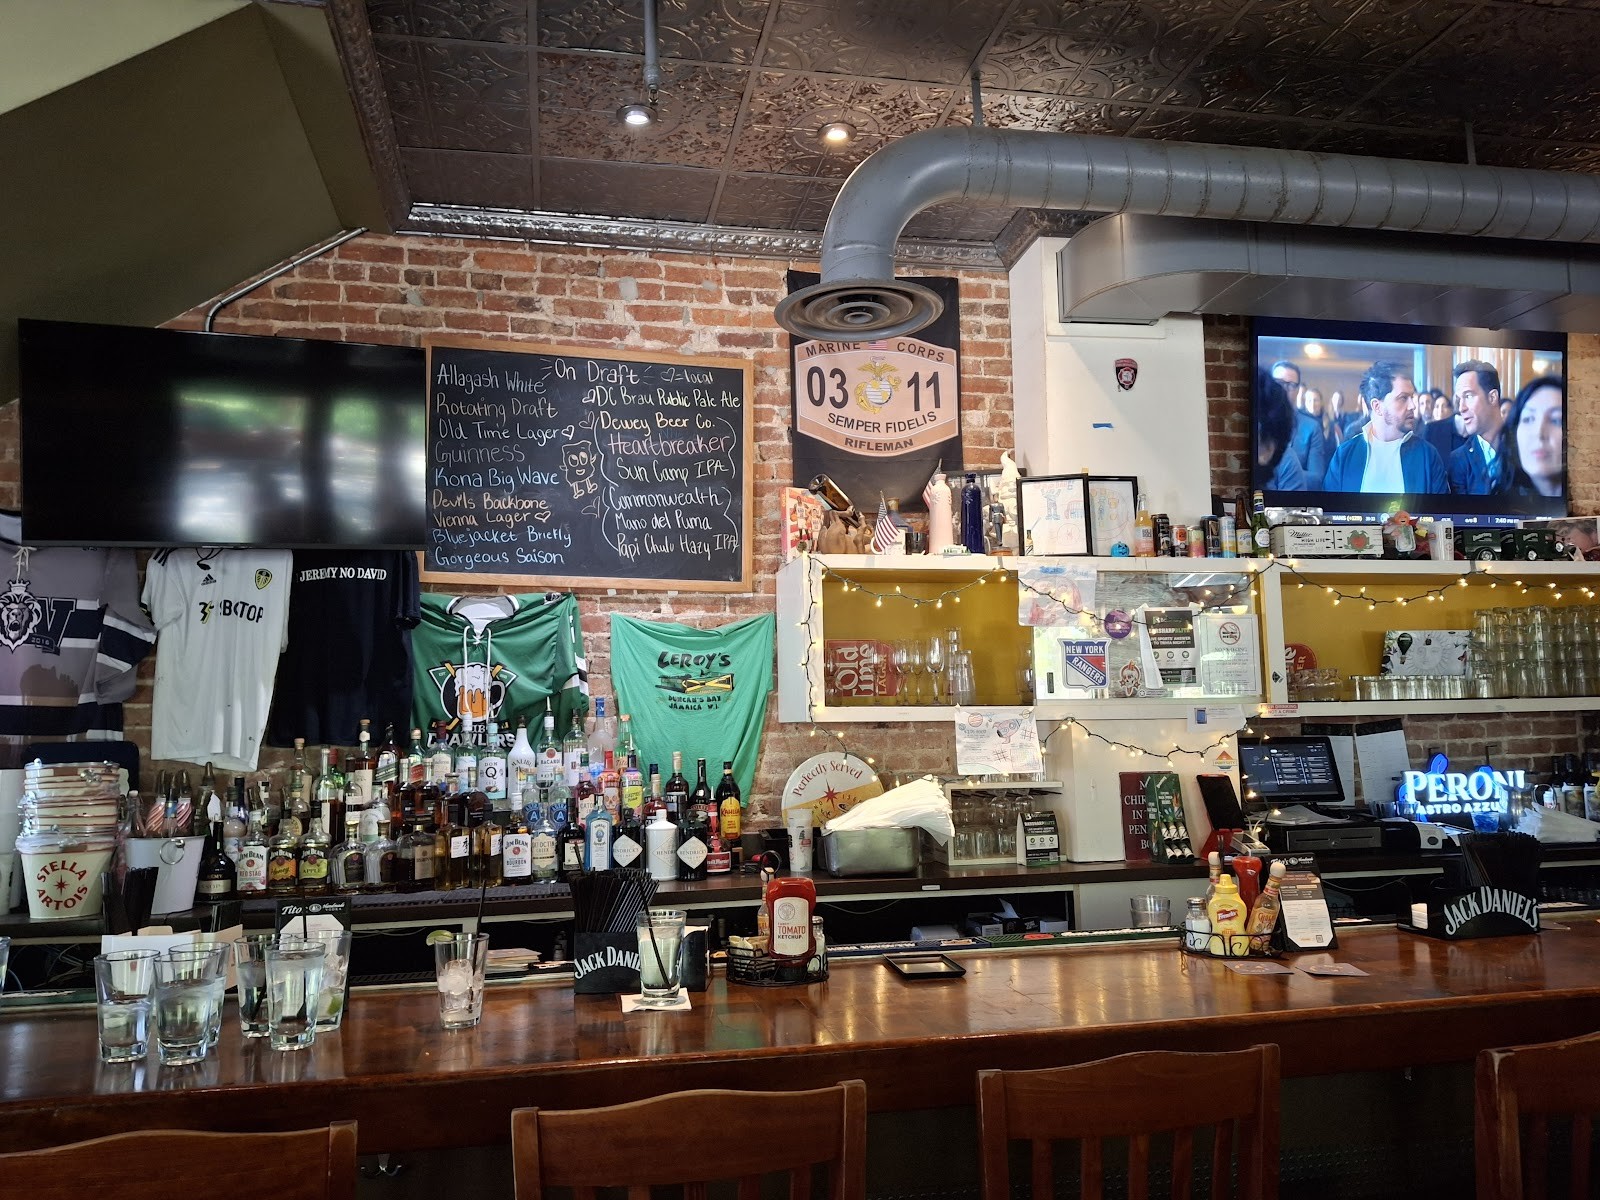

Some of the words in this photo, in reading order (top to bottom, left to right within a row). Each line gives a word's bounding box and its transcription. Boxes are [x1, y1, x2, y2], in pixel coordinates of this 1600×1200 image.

[805, 341, 861, 358] MARINE
[896, 342, 945, 362] CORPS
[437, 363, 499, 395] Allagash
[505, 370, 547, 394] White
[555, 358, 576, 380] On
[587, 360, 640, 385] Draft
[595, 385, 617, 407] DC
[620, 385, 655, 405] Brau
[657, 387, 691, 407] Public
[693, 388, 717, 407] Pale
[720, 390, 741, 408] Ale
[806, 365, 849, 410] 03
[907, 371, 941, 412] 11
[436, 392, 506, 427] Rotating
[511, 396, 558, 419] Draft
[439, 418, 468, 440] Old
[472, 421, 511, 440] Time
[516, 422, 560, 447] Lager
[599, 410, 651, 437] Dewey
[655, 411, 690, 429] Beer
[695, 413, 715, 429] Co.
[827, 412, 881, 434] SEMPER
[885, 411, 937, 434] FIDELIS
[435, 440, 525, 468] Guinness
[607, 431, 731, 457] Heartbreaker
[844, 437, 914, 452] RIFLEMAN
[435, 466, 483, 487] Kona
[487, 468, 515, 494] Big
[516, 464, 560, 485] Wave
[616, 456, 650, 483] Sun
[653, 459, 689, 487] Camp
[693, 458, 729, 479] IPA
[483, 491, 549, 510] Backbone
[609, 486, 724, 511] Commonwealth
[433, 512, 479, 528] Vienna
[486, 511, 531, 529] Lager
[614, 512, 647, 531] Mano
[651, 511, 672, 530] del
[675, 508, 713, 531] Puma
[432, 527, 518, 548] Bluejacket
[617, 532, 641, 562] Papi
[644, 533, 675, 554] Chulo
[679, 533, 711, 561] Hazy
[712, 533, 737, 551] IPA
[435, 546, 509, 570] Gorgeous
[516, 547, 565, 564] Saison
[300, 567, 339, 582] JEREMY
[339, 567, 355, 579] NO
[356, 567, 387, 580] DAVID
[657, 651, 731, 669] LEROY'S
[1066, 645, 1083, 654] NEW
[1084, 645, 1105, 654] YORK
[834, 645, 859, 691] Old
[1071, 656, 1106, 684] RANGERS
[668, 695, 705, 703] DUNCAN'S
[706, 695, 722, 703] BAY
[668, 703, 702, 711] JAMAICA
[485, 766, 497, 779] Q
[792, 761, 828, 797] Perfectly
[830, 760, 863, 780] Served
[1403, 770, 1526, 802] PERONI
[240, 851, 249, 860] JIM
[248, 850, 264, 861] BEAM
[504, 840, 514, 850] JIM
[514, 838, 529, 849] BEAM
[36, 859, 88, 883] STELLA
[36, 885, 89, 911] ARTOIS
[1443, 890, 1485, 936] JACK
[1479, 885, 1539, 932] DANIEL'S
[777, 925, 806, 935] TOMATO
[573, 951, 606, 979] JACK
